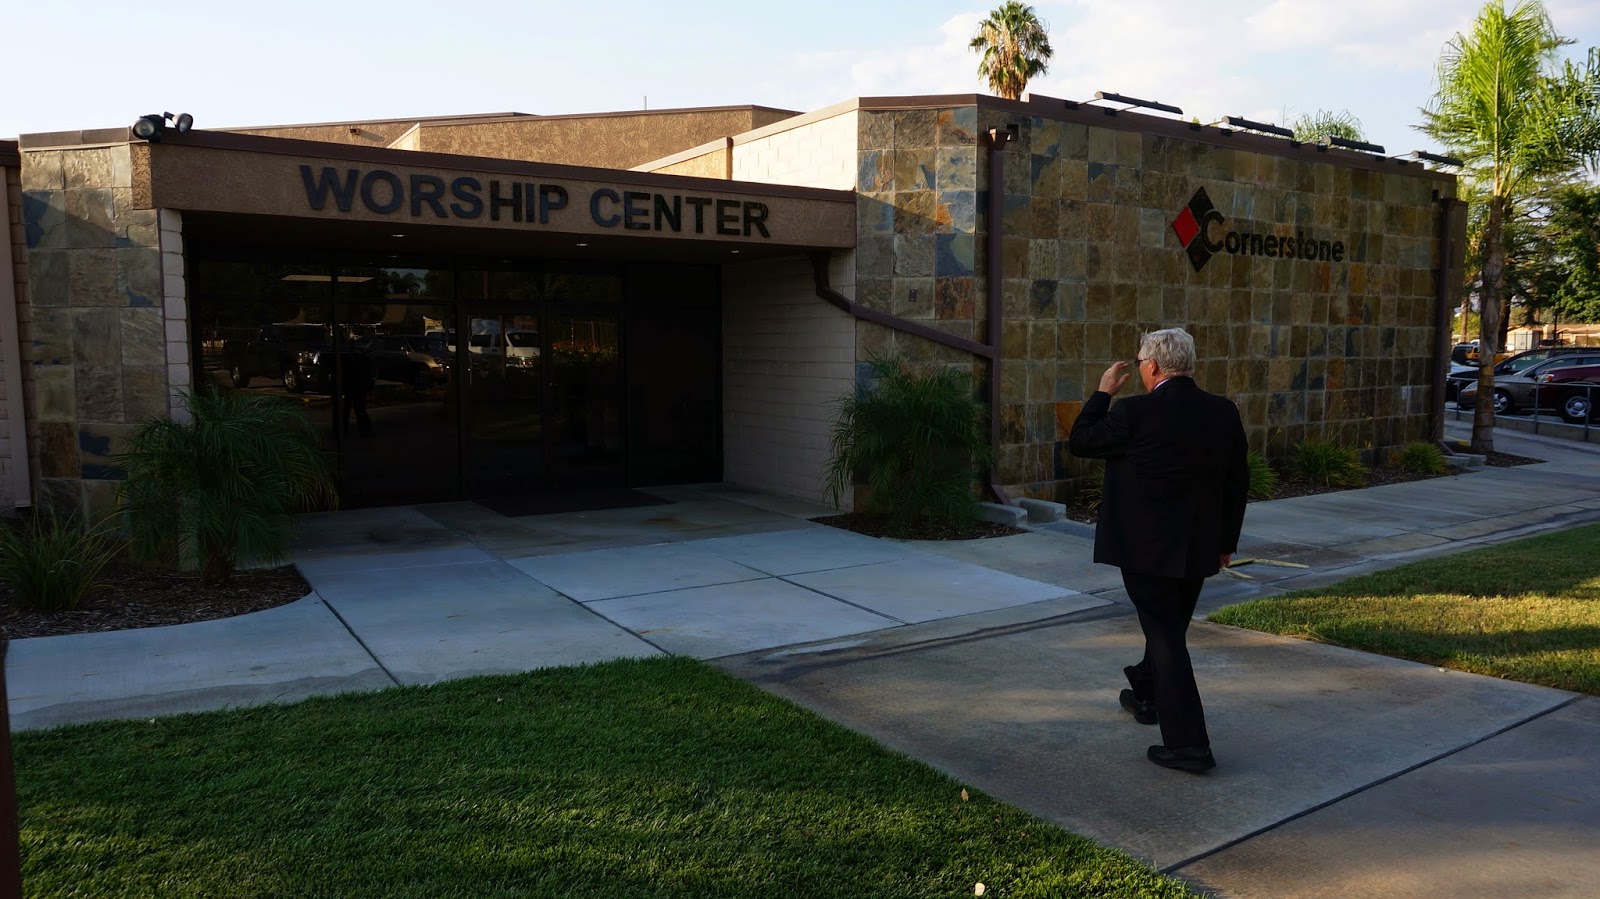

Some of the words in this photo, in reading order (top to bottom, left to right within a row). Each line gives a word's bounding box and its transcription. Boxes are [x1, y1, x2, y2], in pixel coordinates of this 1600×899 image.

[300, 165, 568, 224] WORSHIP
[590, 187, 770, 238] CENTER
[1201, 211, 1344, 262] Cornerstone
